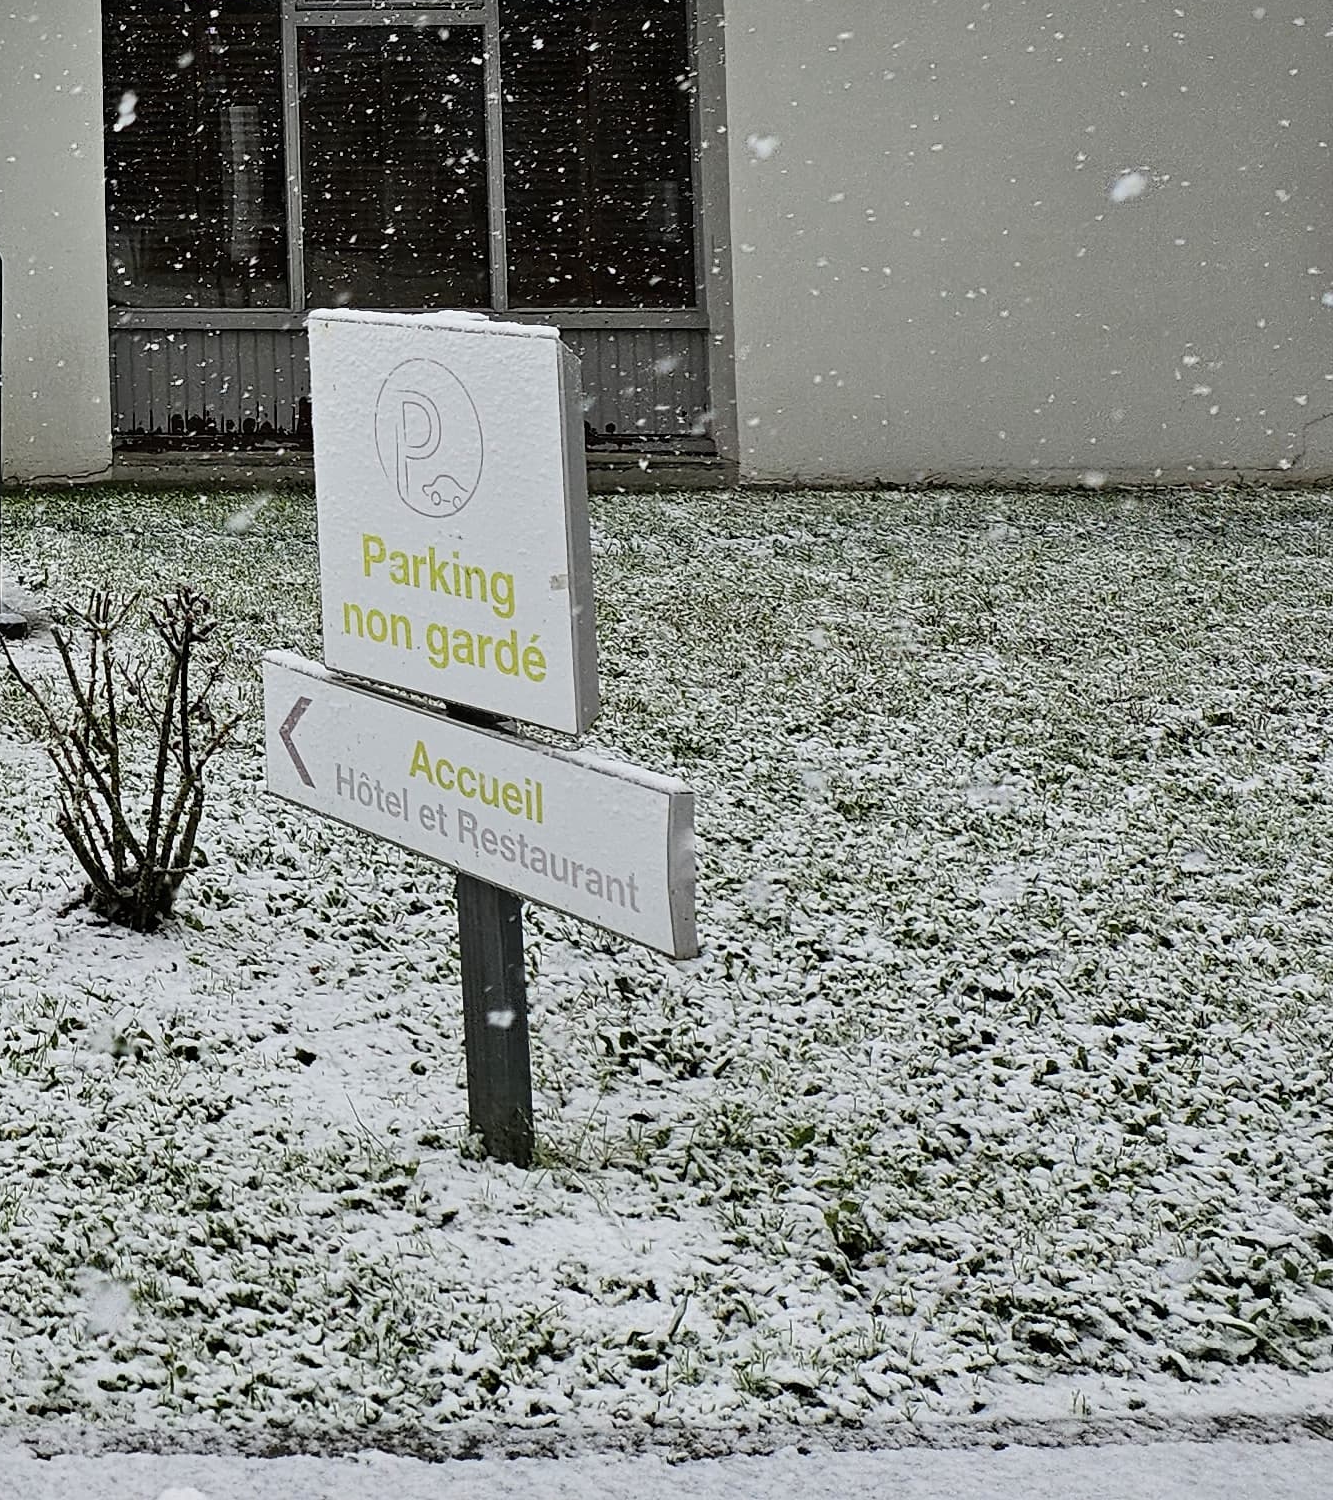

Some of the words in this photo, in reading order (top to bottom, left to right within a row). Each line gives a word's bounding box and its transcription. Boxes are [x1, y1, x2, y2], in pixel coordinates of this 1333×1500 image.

[361, 533, 515, 620] Parking
[343, 599, 413, 651] non
[426, 621, 548, 684] gardé
[408, 739, 545, 825] Accueil
[334, 762, 409, 823] Hôtel
[419, 802, 449, 838] et
[458, 808, 641, 914] Restaurant
